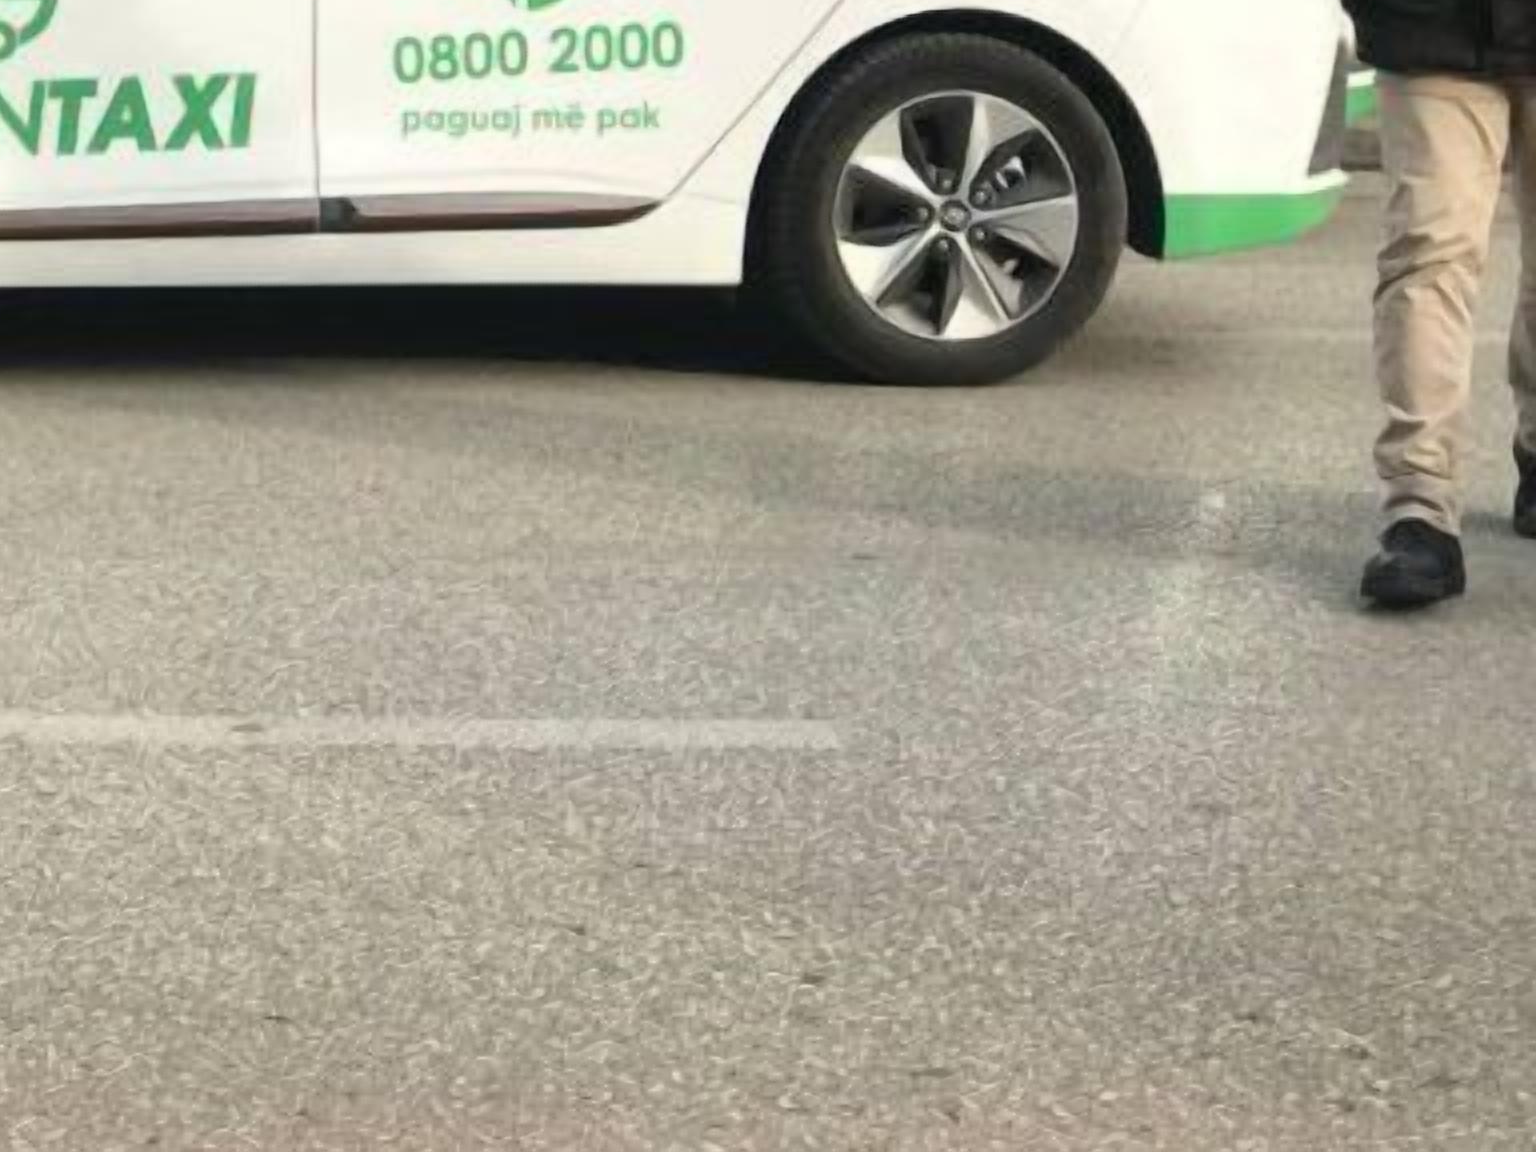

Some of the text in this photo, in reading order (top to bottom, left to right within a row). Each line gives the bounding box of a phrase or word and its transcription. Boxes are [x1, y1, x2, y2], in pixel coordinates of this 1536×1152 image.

[393, 20, 684, 84] 0800 2000
[401, 100, 661, 138] paguaj më pak
